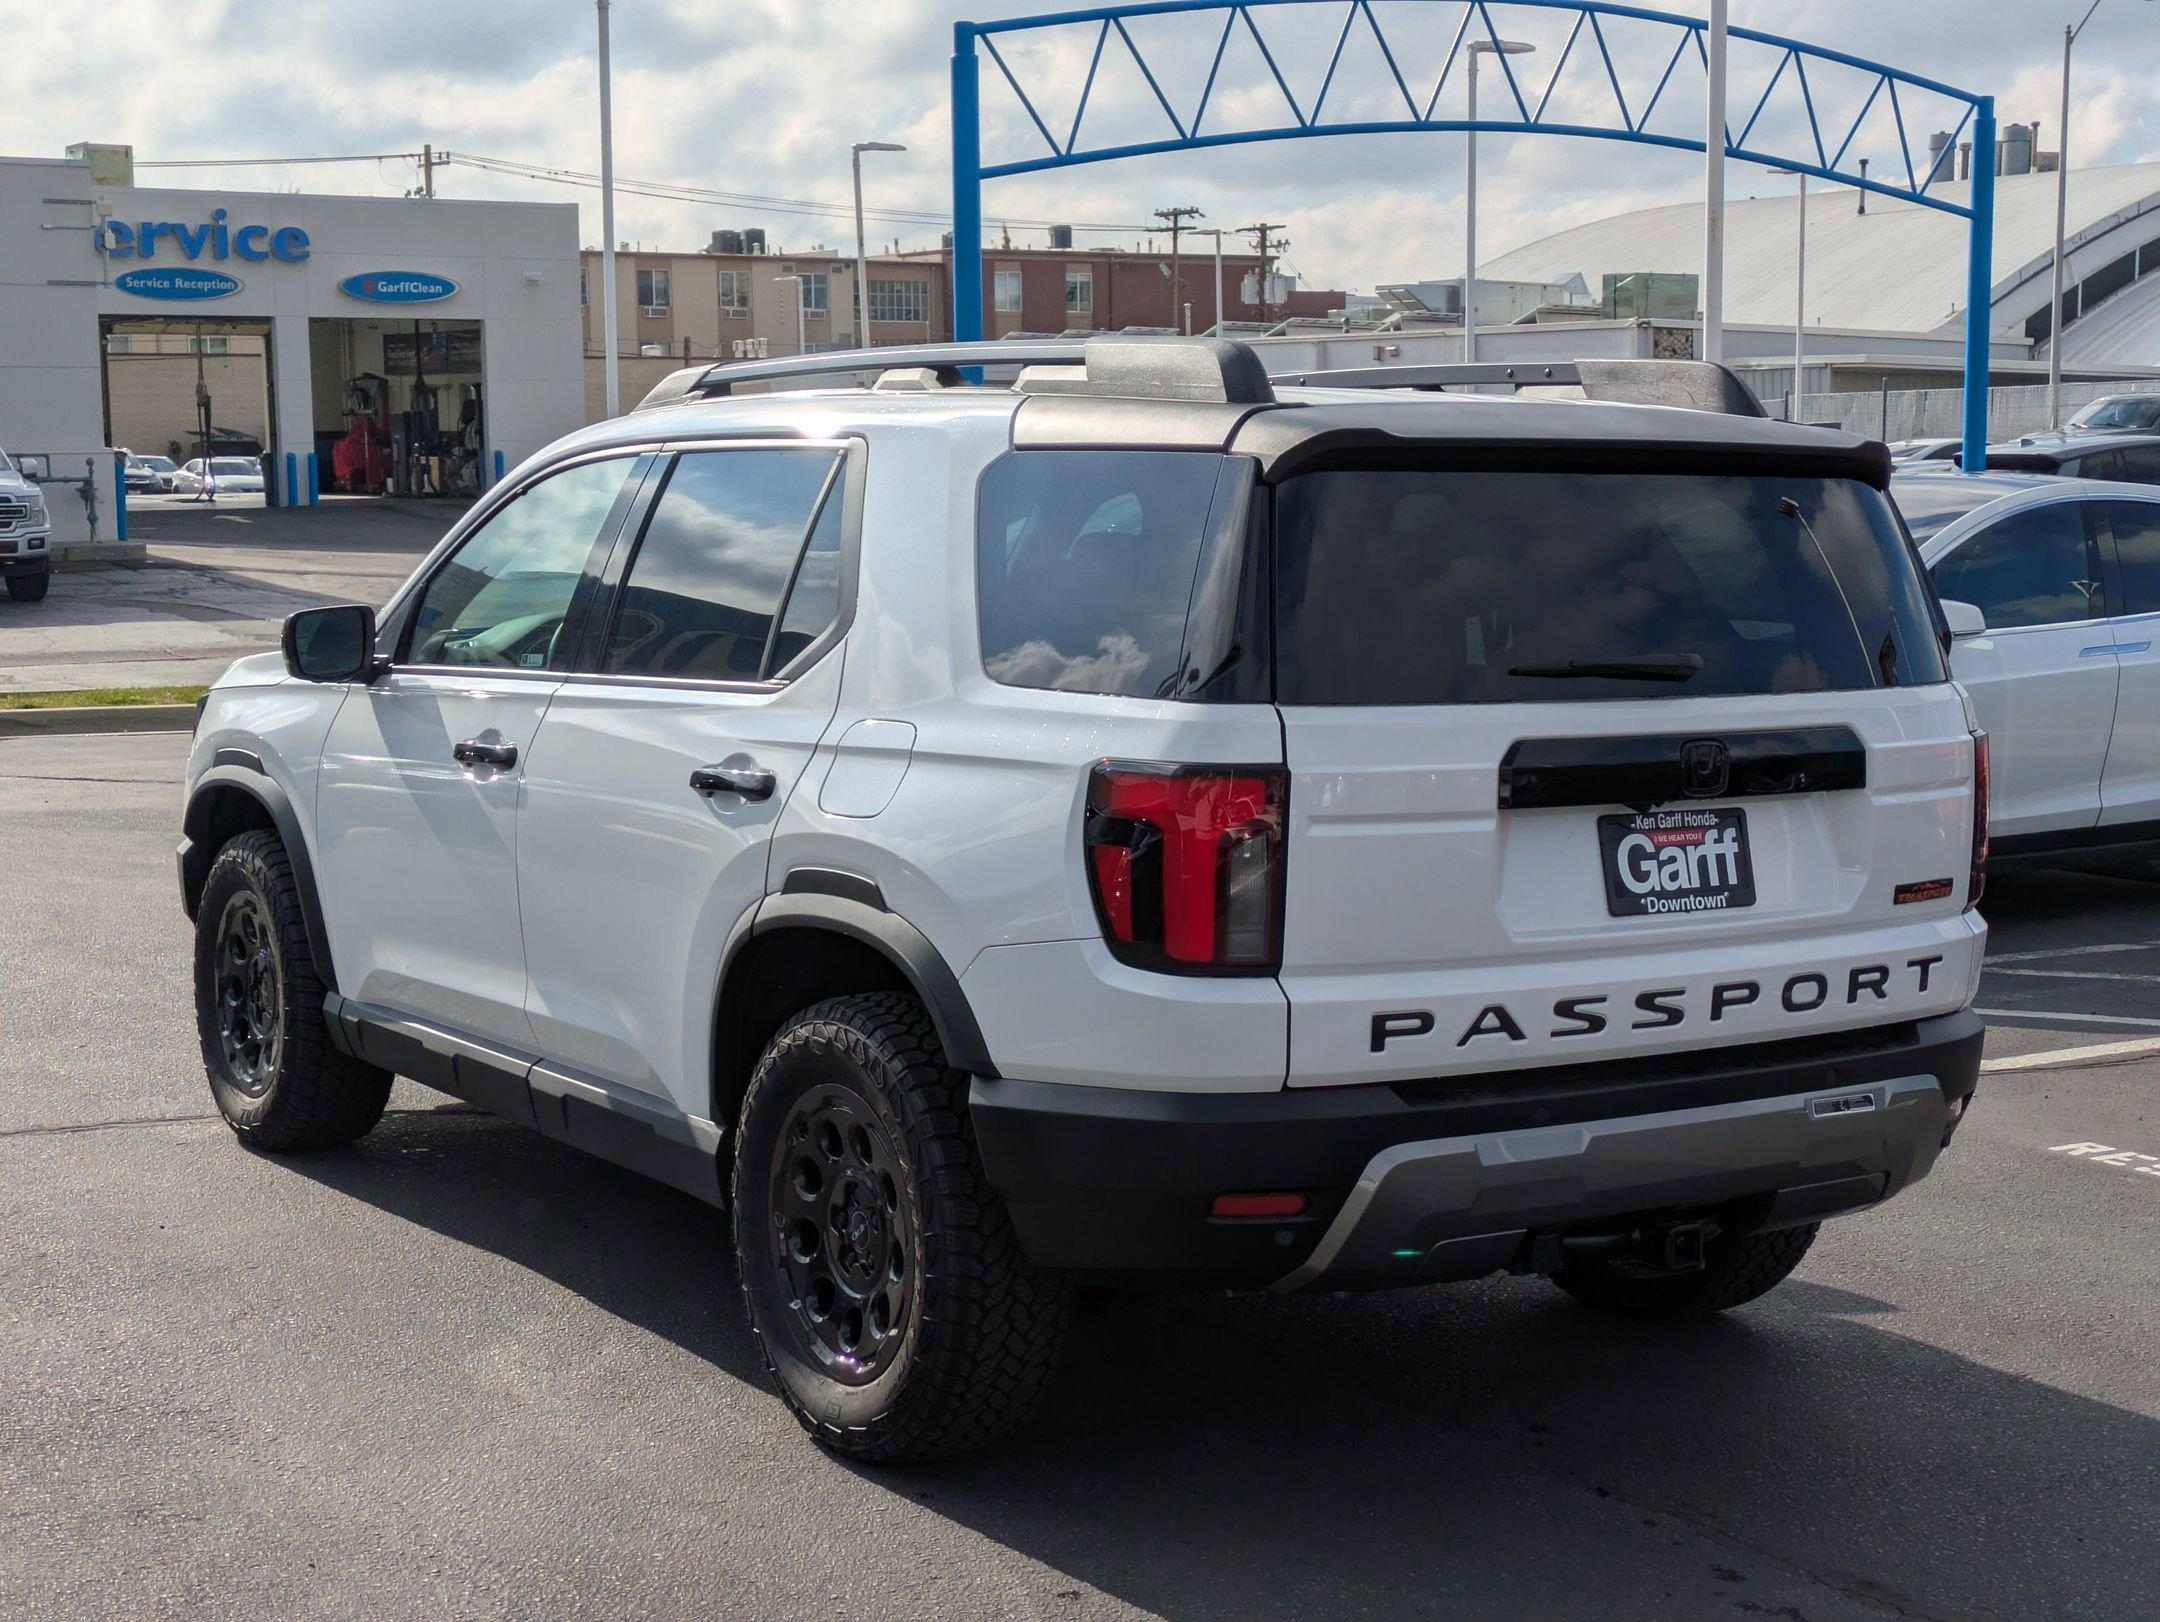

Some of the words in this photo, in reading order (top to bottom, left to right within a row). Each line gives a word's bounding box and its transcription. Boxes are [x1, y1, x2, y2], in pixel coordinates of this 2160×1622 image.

[125, 276, 171, 289] Service
[174, 278, 236, 292] Reception
[377, 281, 443, 293] GarffClean
[1635, 814, 1656, 830] Ken
[1657, 812, 1683, 829] Garff
[1684, 811, 1716, 828] Honda
[1657, 834, 1668, 843] WE
[1668, 833, 1685, 842] HEAR
[1685, 832, 1698, 841] YOU
[1617, 827, 1739, 894] Garff
[1646, 894, 1727, 913] Downtown
[1369, 953, 1945, 1054] PASSPORT
